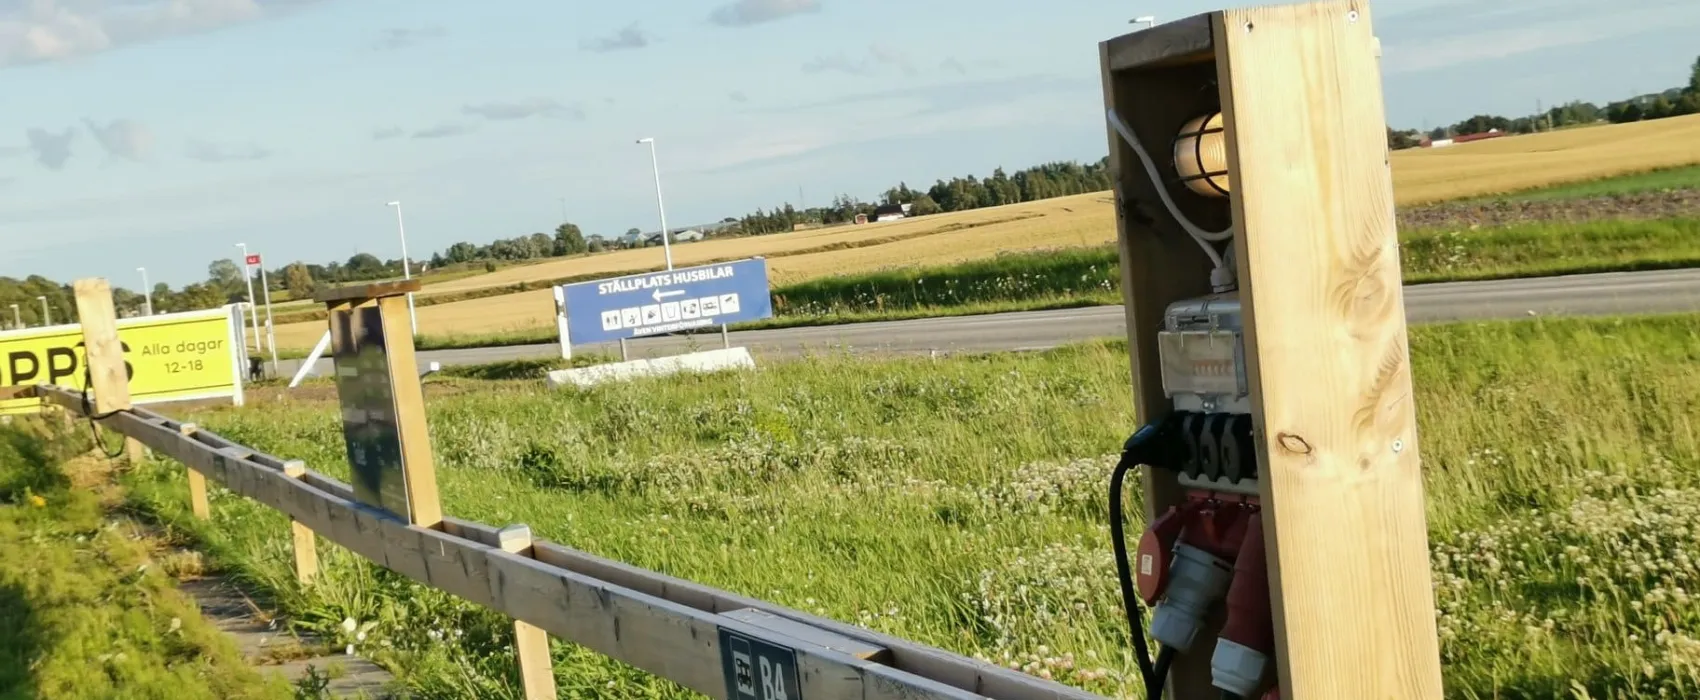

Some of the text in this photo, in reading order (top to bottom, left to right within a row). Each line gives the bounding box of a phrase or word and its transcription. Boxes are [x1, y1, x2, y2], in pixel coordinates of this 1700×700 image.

[598, 266, 734, 295] STÄLLPLATS HUSBILAR
[142, 339, 223, 356] Alla dagar
[164, 359, 203, 374] 12-18
[759, 655, 788, 700] B4
